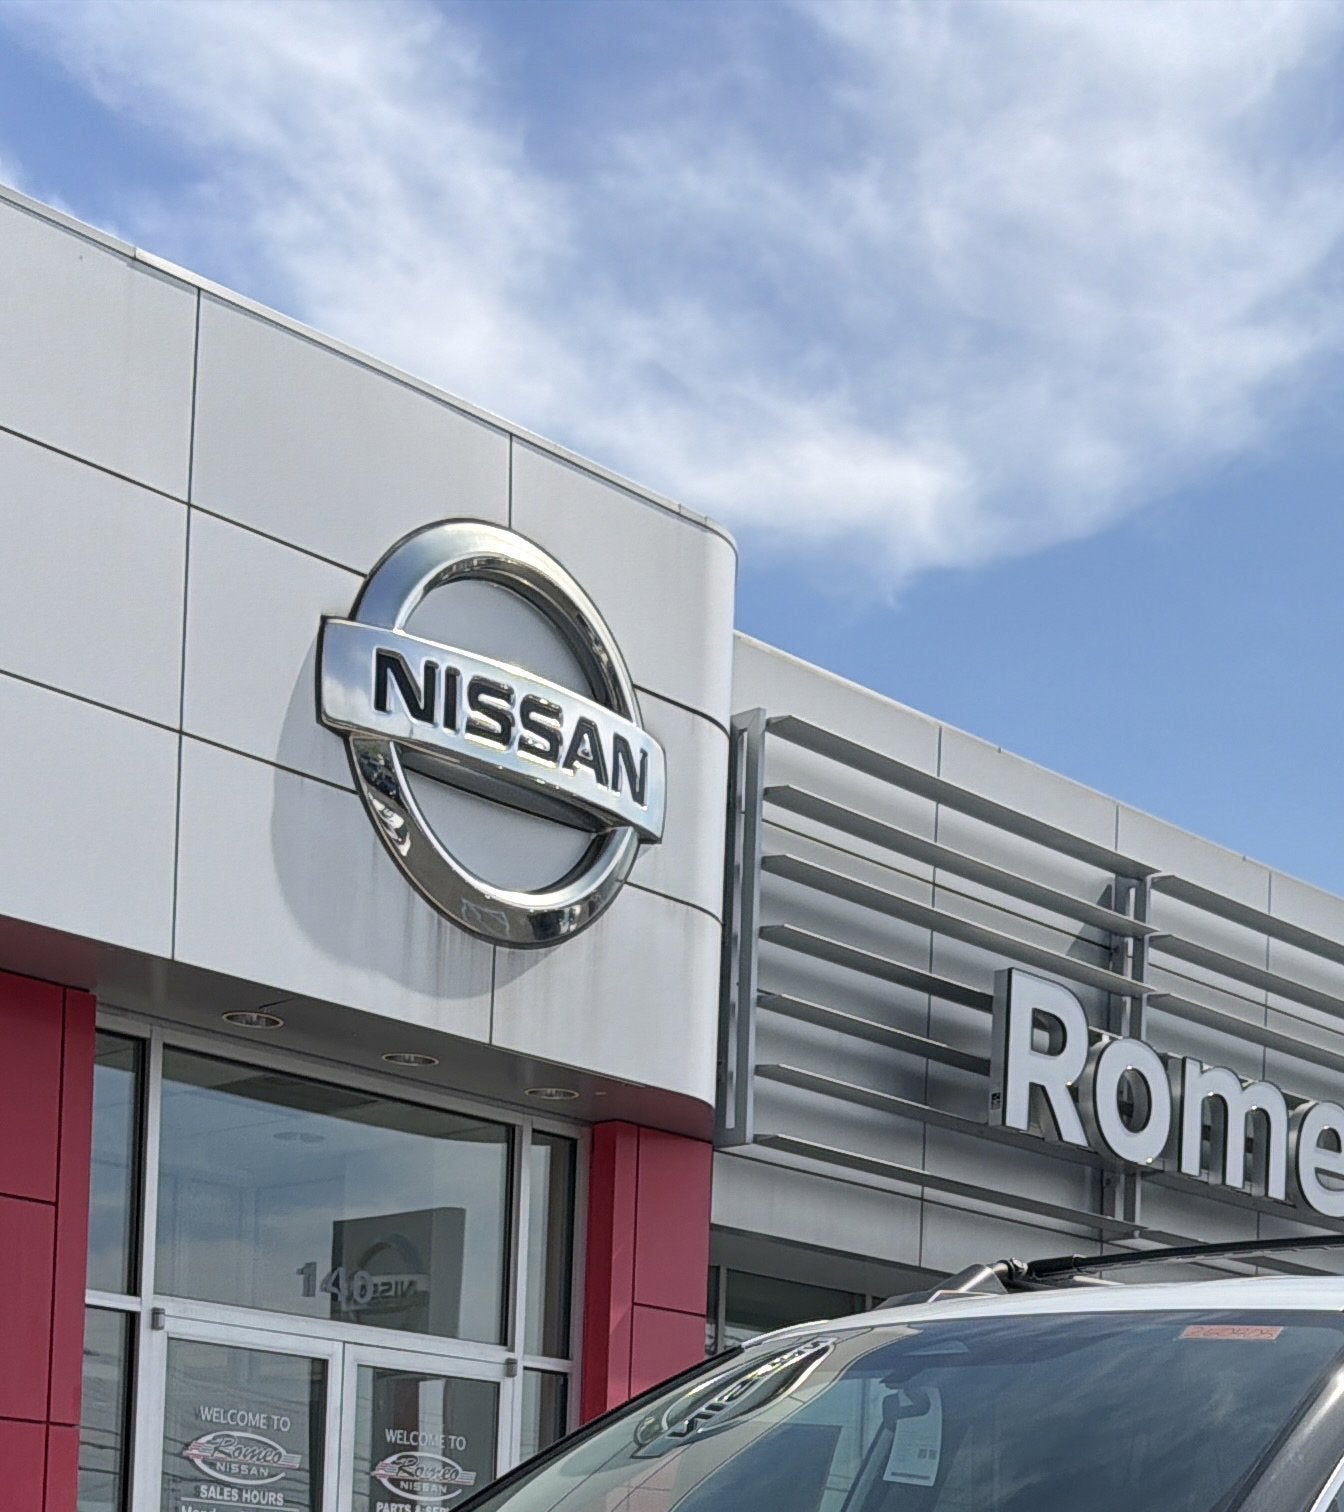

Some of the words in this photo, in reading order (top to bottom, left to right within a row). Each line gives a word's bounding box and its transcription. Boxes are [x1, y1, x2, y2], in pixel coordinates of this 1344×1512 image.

[373, 647, 648, 809] NISSAN
[296, 1261, 374, 1312] 140
[199, 1405, 268, 1429] WELCOME
[271, 1415, 291, 1431] TO
[205, 1433, 283, 1464] Romeo
[385, 1428, 446, 1448] WELCOME
[448, 1435, 467, 1451] TO
[215, 1461, 269, 1477] NISSAN
[391, 1455, 460, 1481] Romeo
[199, 1485, 239, 1501] SALES
[242, 1490, 284, 1506] HOURS
[399, 1480, 448, 1494] NISSAN
